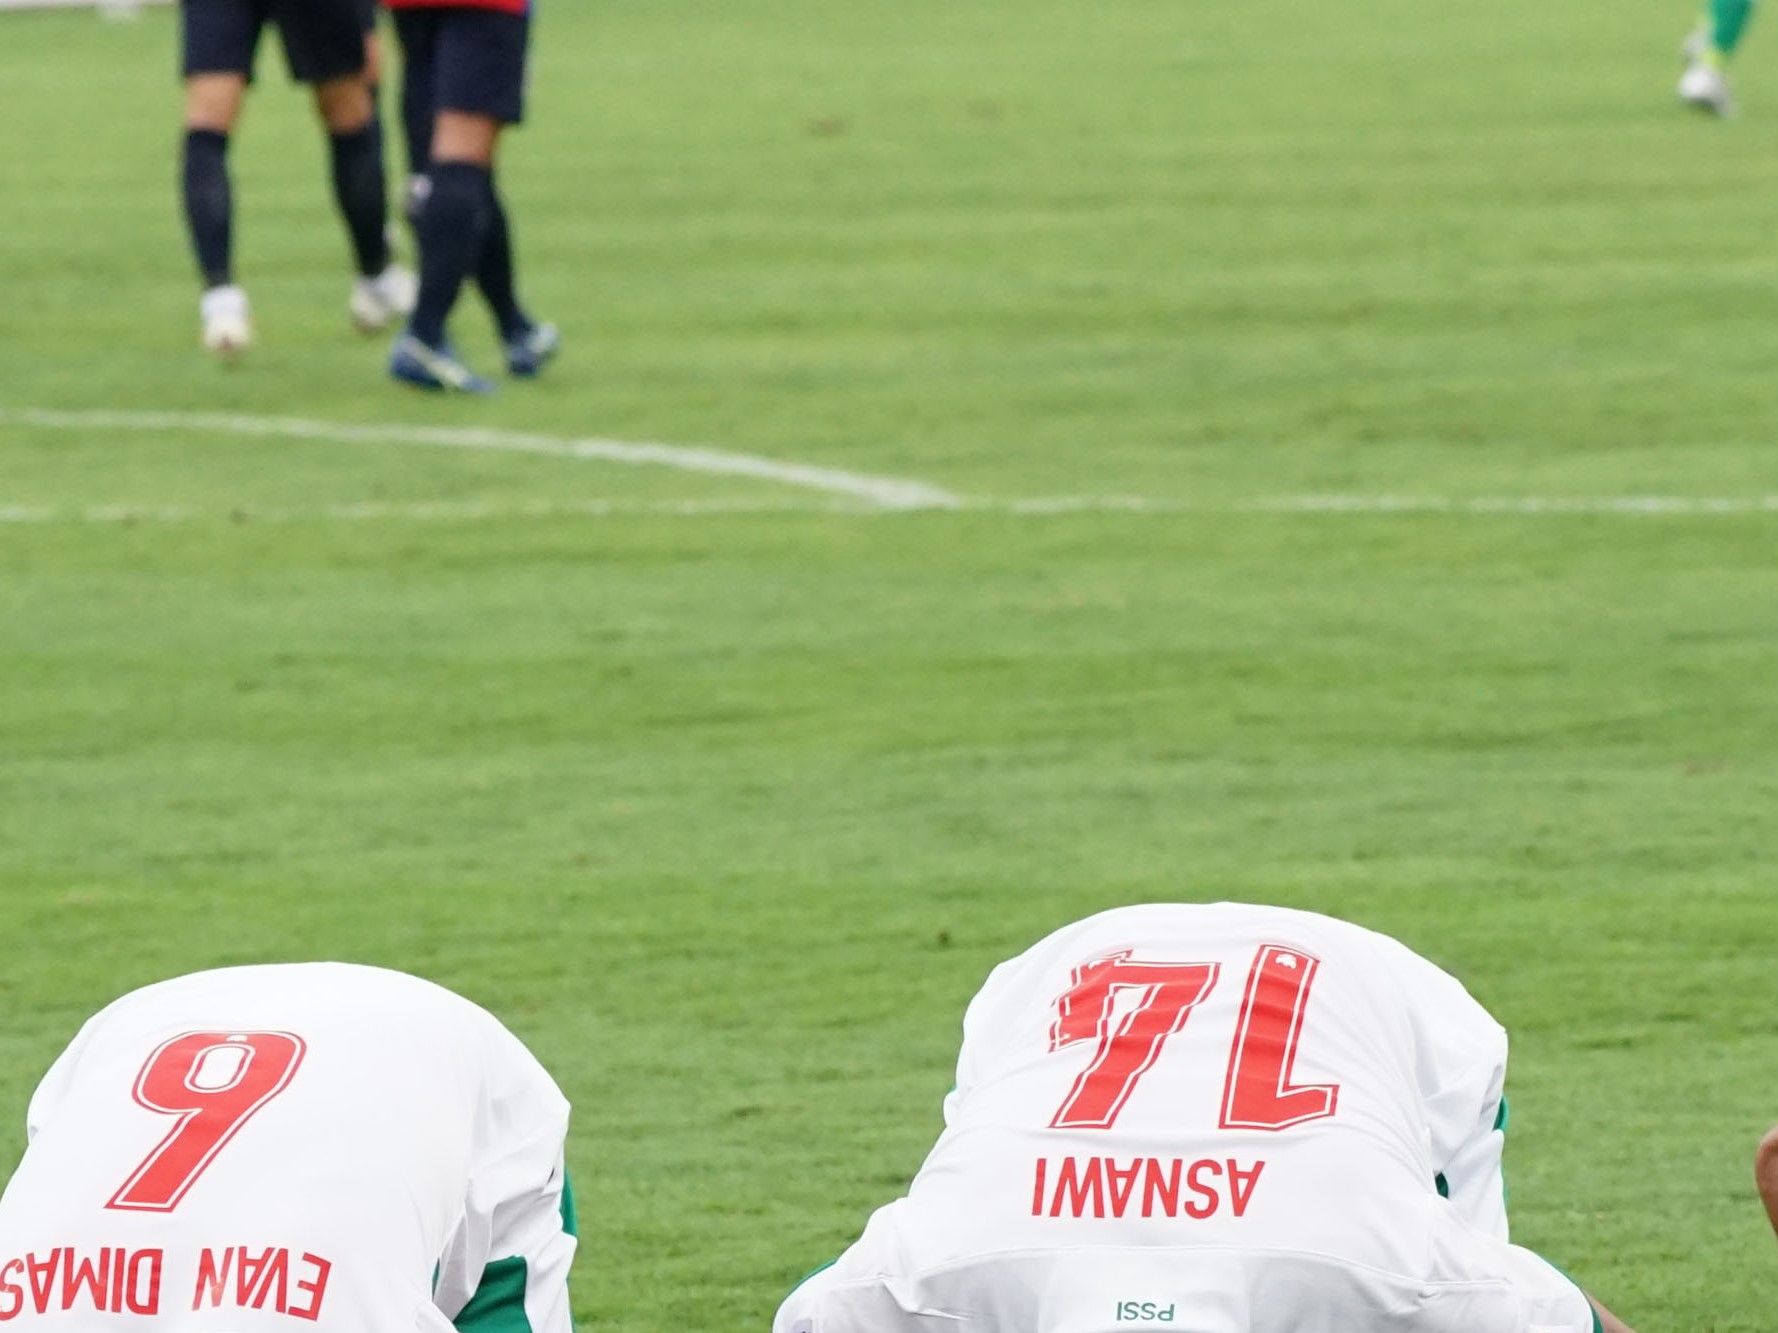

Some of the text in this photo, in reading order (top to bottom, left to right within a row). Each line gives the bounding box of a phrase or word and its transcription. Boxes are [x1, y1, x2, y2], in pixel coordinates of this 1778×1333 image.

[1048, 944, 1341, 1132] 14
[103, 1031, 306, 1213] 6
[1031, 1156, 1266, 1220] ASNAWI
[0, 1246, 332, 1321] EVAN DIMAS
[1116, 1300, 1176, 1322] PSSI
